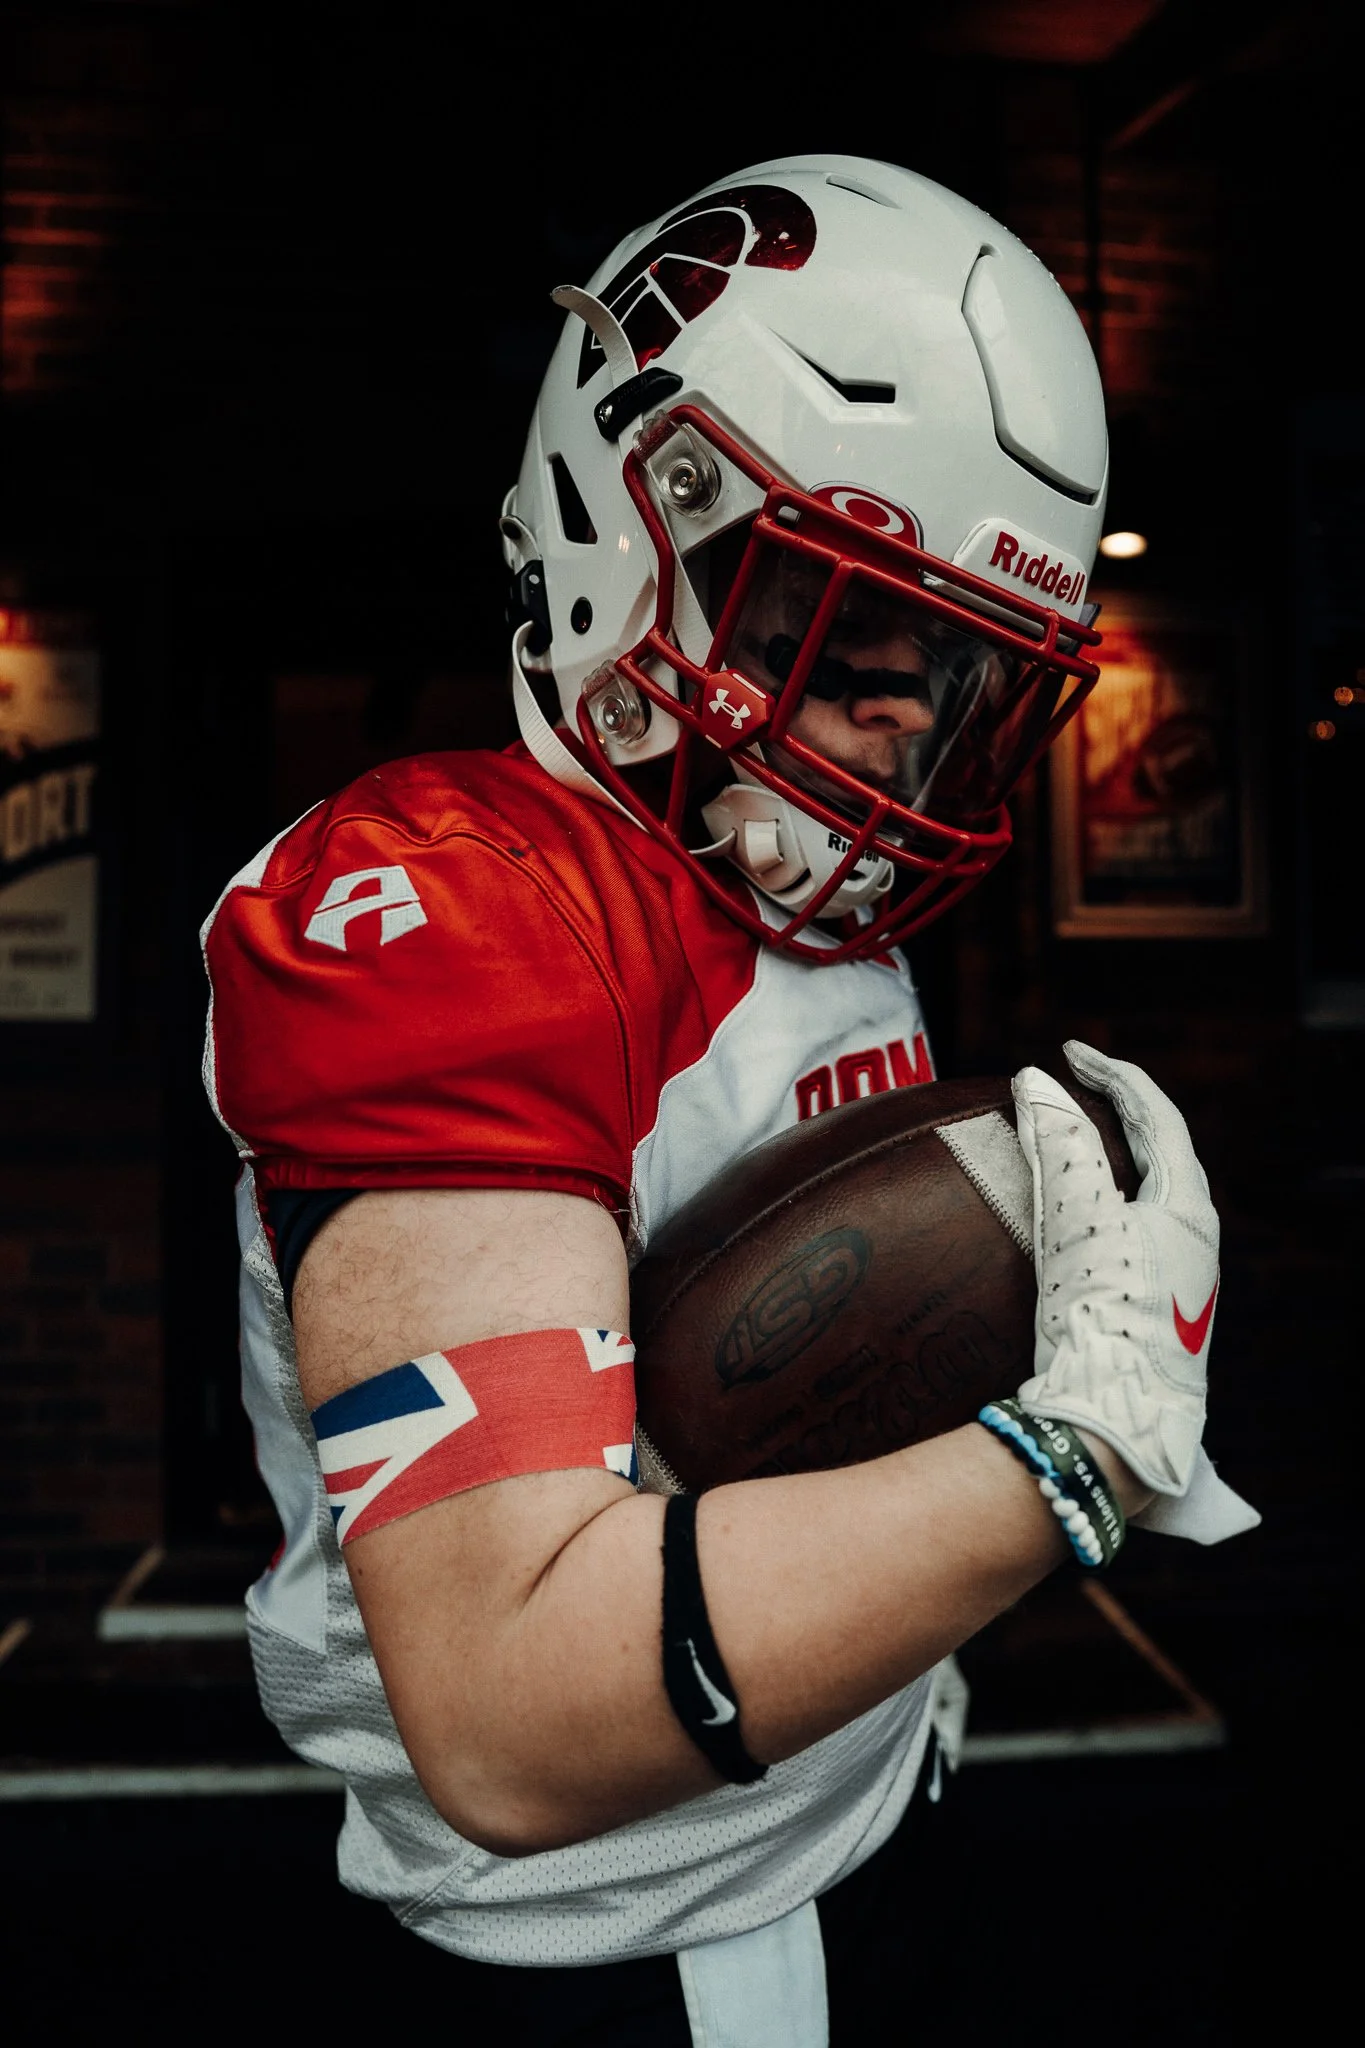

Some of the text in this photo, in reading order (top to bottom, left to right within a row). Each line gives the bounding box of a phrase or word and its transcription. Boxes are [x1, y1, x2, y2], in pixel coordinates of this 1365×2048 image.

[988, 531, 1085, 605] Riddell
[827, 832, 879, 863] Riell
[1072, 1454, 1095, 1487] vs.
[1090, 1485, 1119, 1532] Lions
